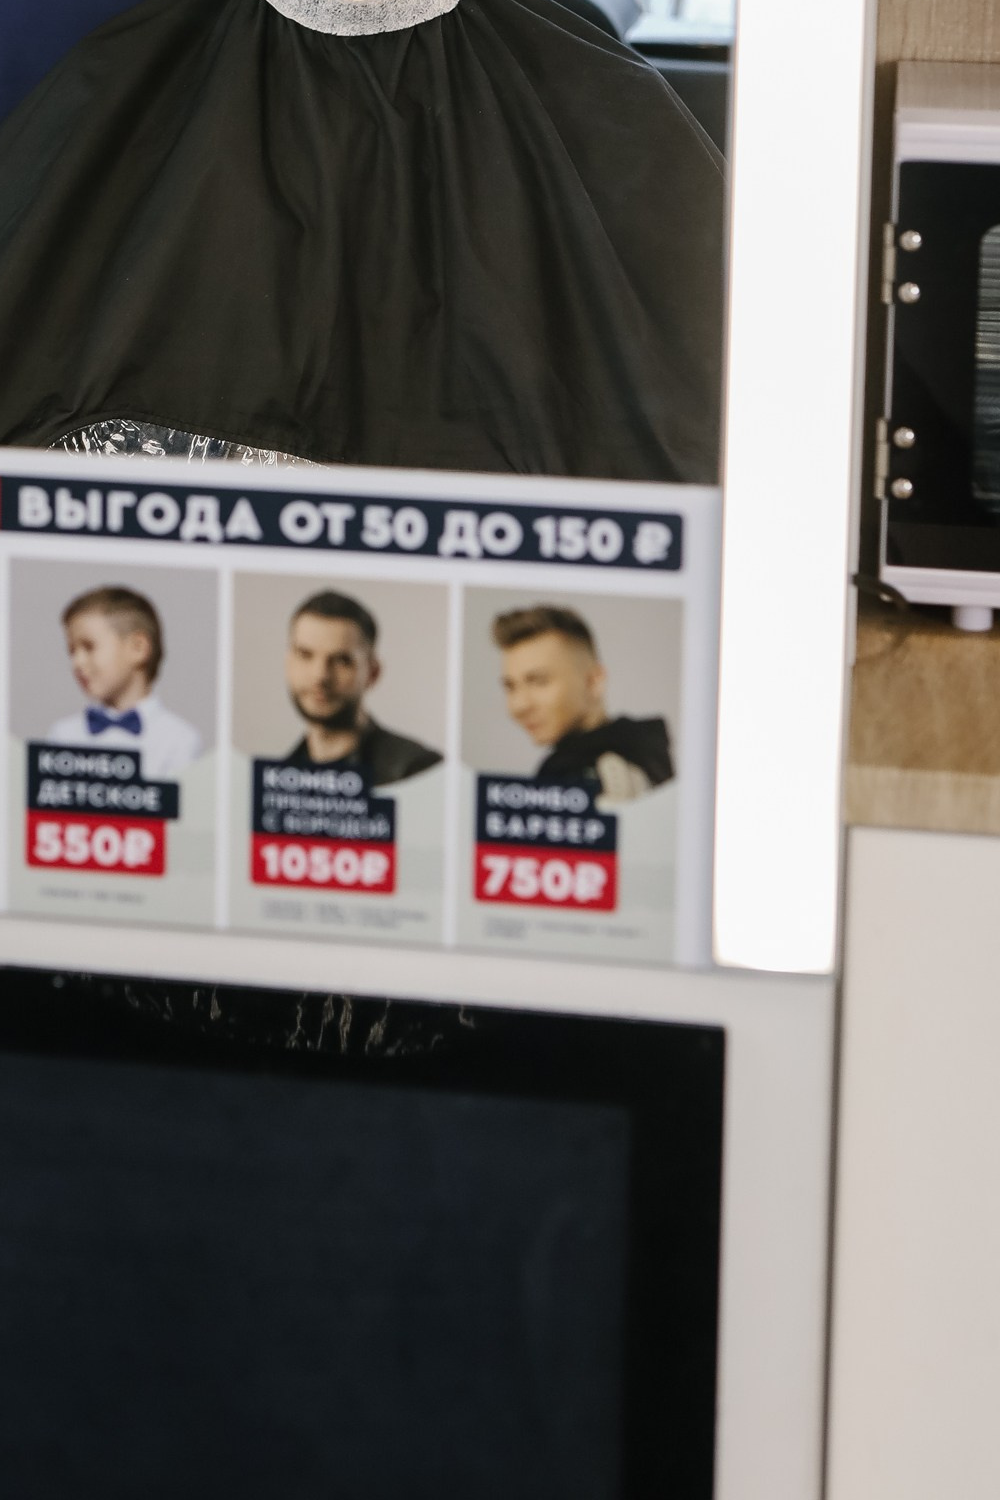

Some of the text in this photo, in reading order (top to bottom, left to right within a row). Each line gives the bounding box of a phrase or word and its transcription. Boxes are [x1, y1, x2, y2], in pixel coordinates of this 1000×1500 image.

[18, 485, 263, 543] ВЫГОДА
[279, 502, 355, 545] ОТ
[362, 506, 428, 550] 50
[438, 510, 523, 559] ДО
[533, 516, 623, 562] 150
[38, 750, 136, 780] КОМБО
[37, 779, 161, 812] ДЕТСКОЕ
[263, 766, 363, 797] КОМБО
[487, 783, 589, 813] КОМБО
[487, 814, 605, 845] БАРБЕР
